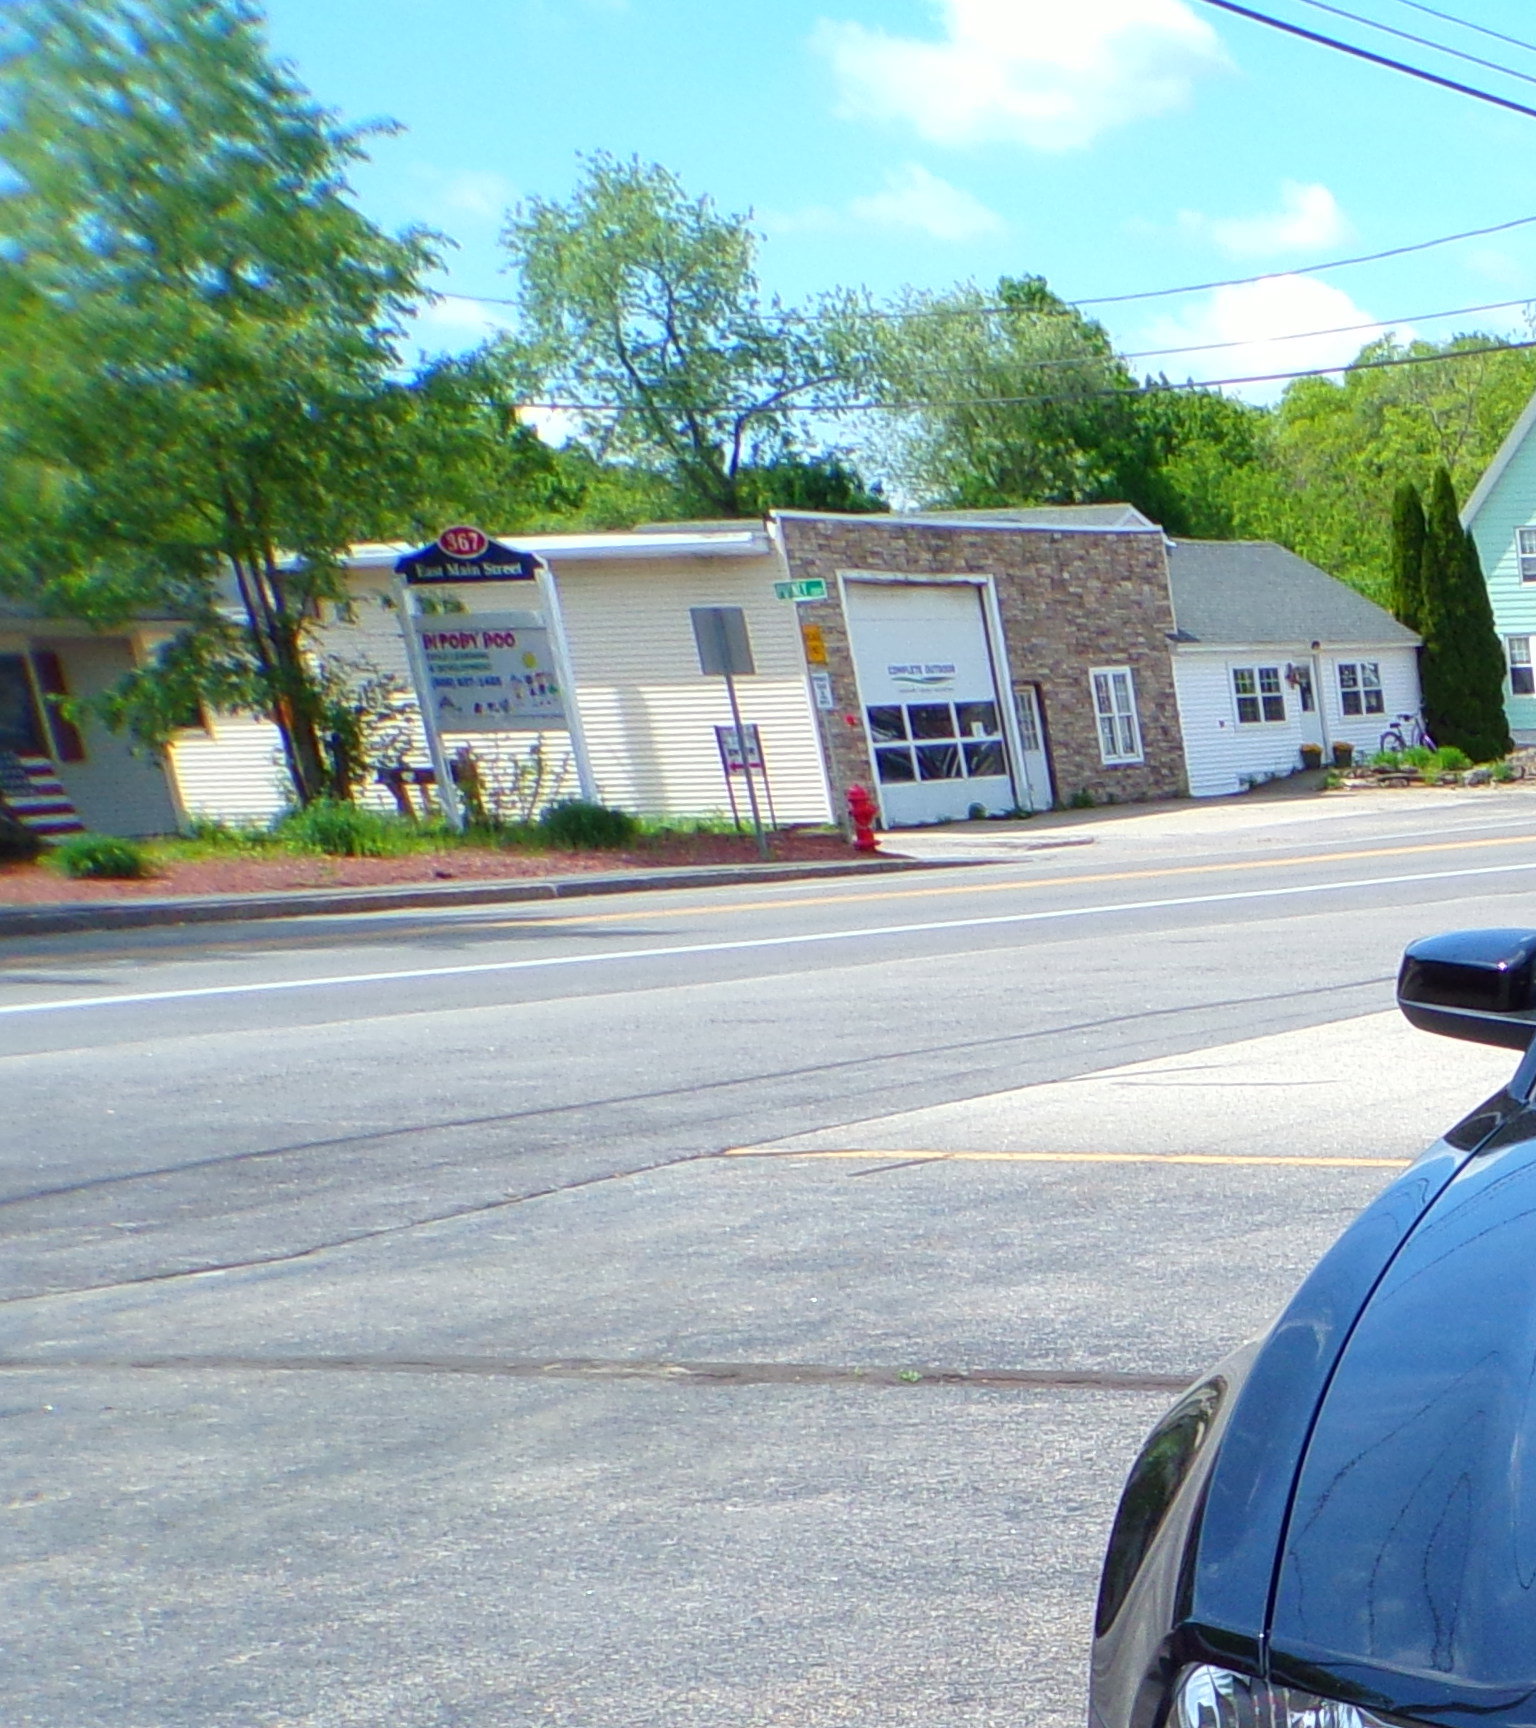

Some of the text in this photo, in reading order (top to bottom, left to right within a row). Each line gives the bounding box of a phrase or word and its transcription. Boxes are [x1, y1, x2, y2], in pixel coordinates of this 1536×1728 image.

[445, 532, 479, 552] 367
[415, 561, 523, 578] East Main Street
